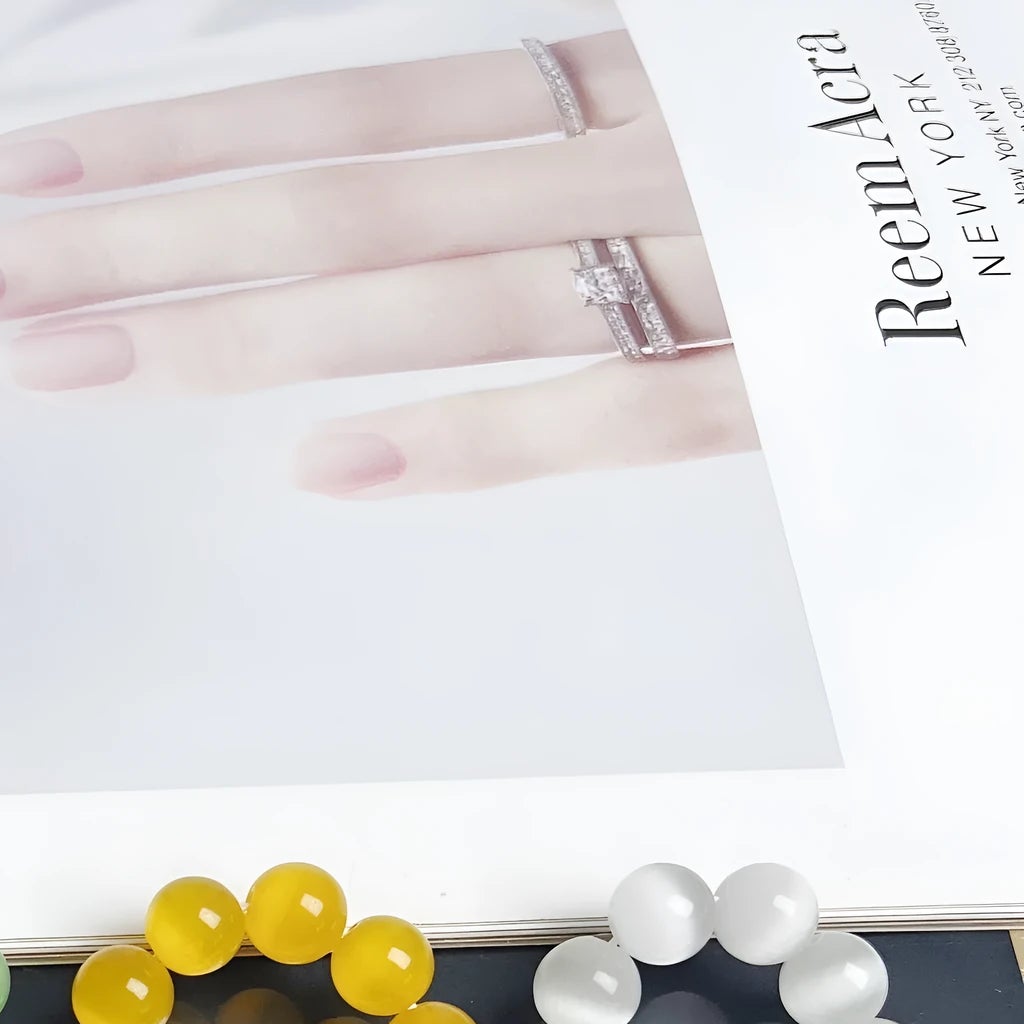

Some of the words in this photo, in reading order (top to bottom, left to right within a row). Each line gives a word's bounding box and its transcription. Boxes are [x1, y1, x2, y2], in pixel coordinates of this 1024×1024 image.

[935, 36, 966, 62] 308
[952, 66, 982, 91] 212
[796, 29, 895, 148] Acra
[892, 72, 965, 166] YORK
[968, 99, 999, 122] NY
[985, 126, 1017, 161] York
[855, 155, 967, 347] Reem
[945, 187, 1012, 276] NEW
